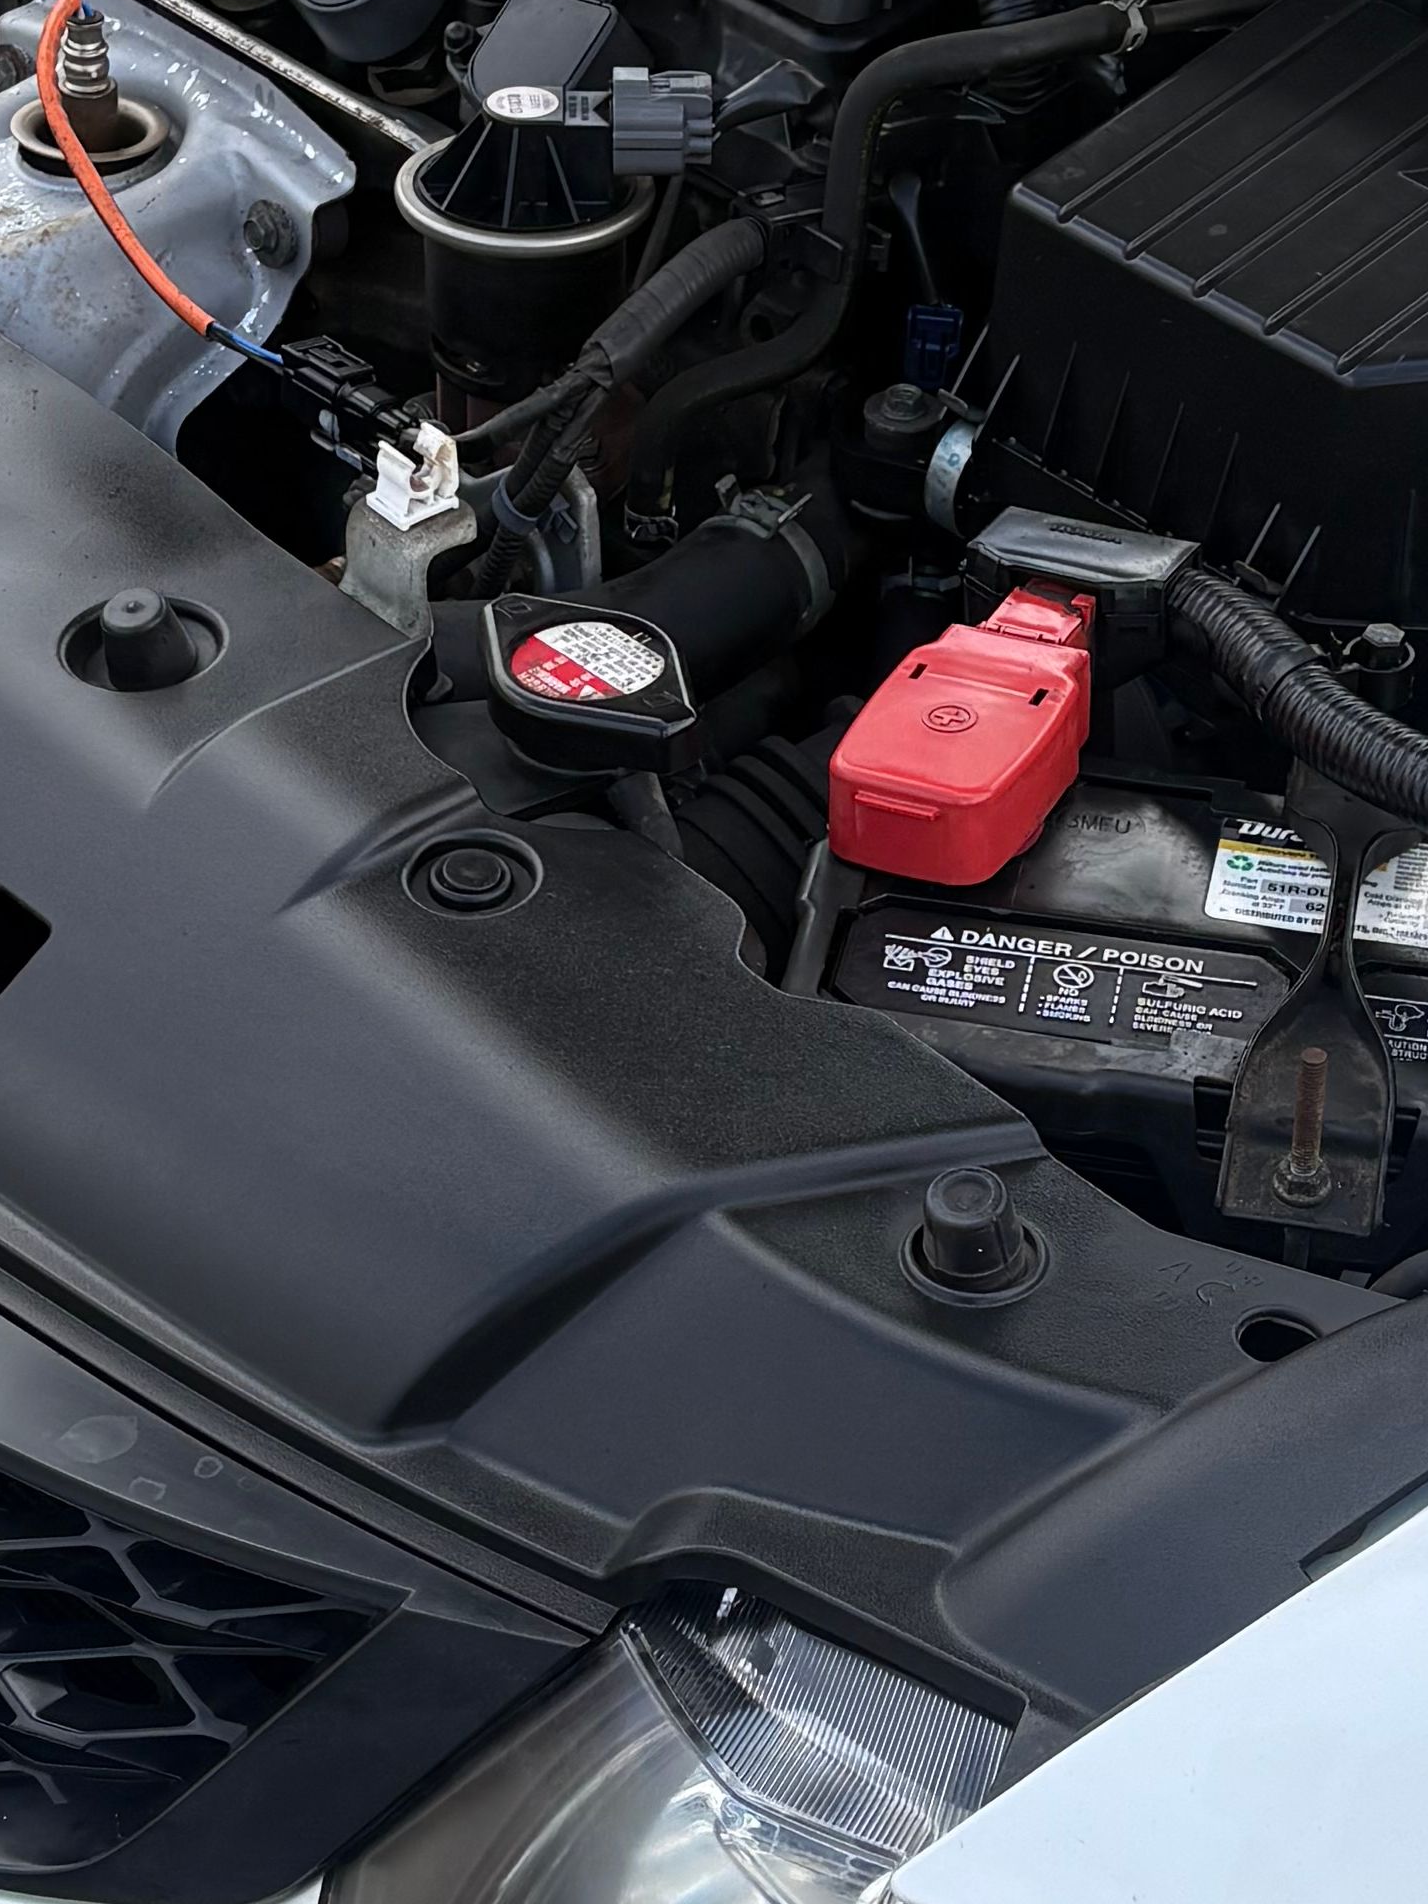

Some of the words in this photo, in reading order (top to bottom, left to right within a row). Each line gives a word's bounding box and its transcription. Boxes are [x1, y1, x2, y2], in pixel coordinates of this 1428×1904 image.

[960, 929, 1072, 957] DANGER
[1102, 948, 1205, 974] POISON
[965, 955, 1016, 969] SHIELD
[927, 968, 1005, 986] EXPLOSIVE
[963, 964, 1000, 976] EYES
[887, 981, 911, 990] CAN
[911, 984, 947, 996] CAUSE
[925, 977, 974, 990] GASES
[1058, 986, 1080, 997] NO
[1135, 1006, 1158, 1016] CAN
[1161, 1009, 1198, 1021] CAUSE
[1136, 997, 1207, 1015] SULFURIC
[1209, 1007, 1243, 1020] ACID
